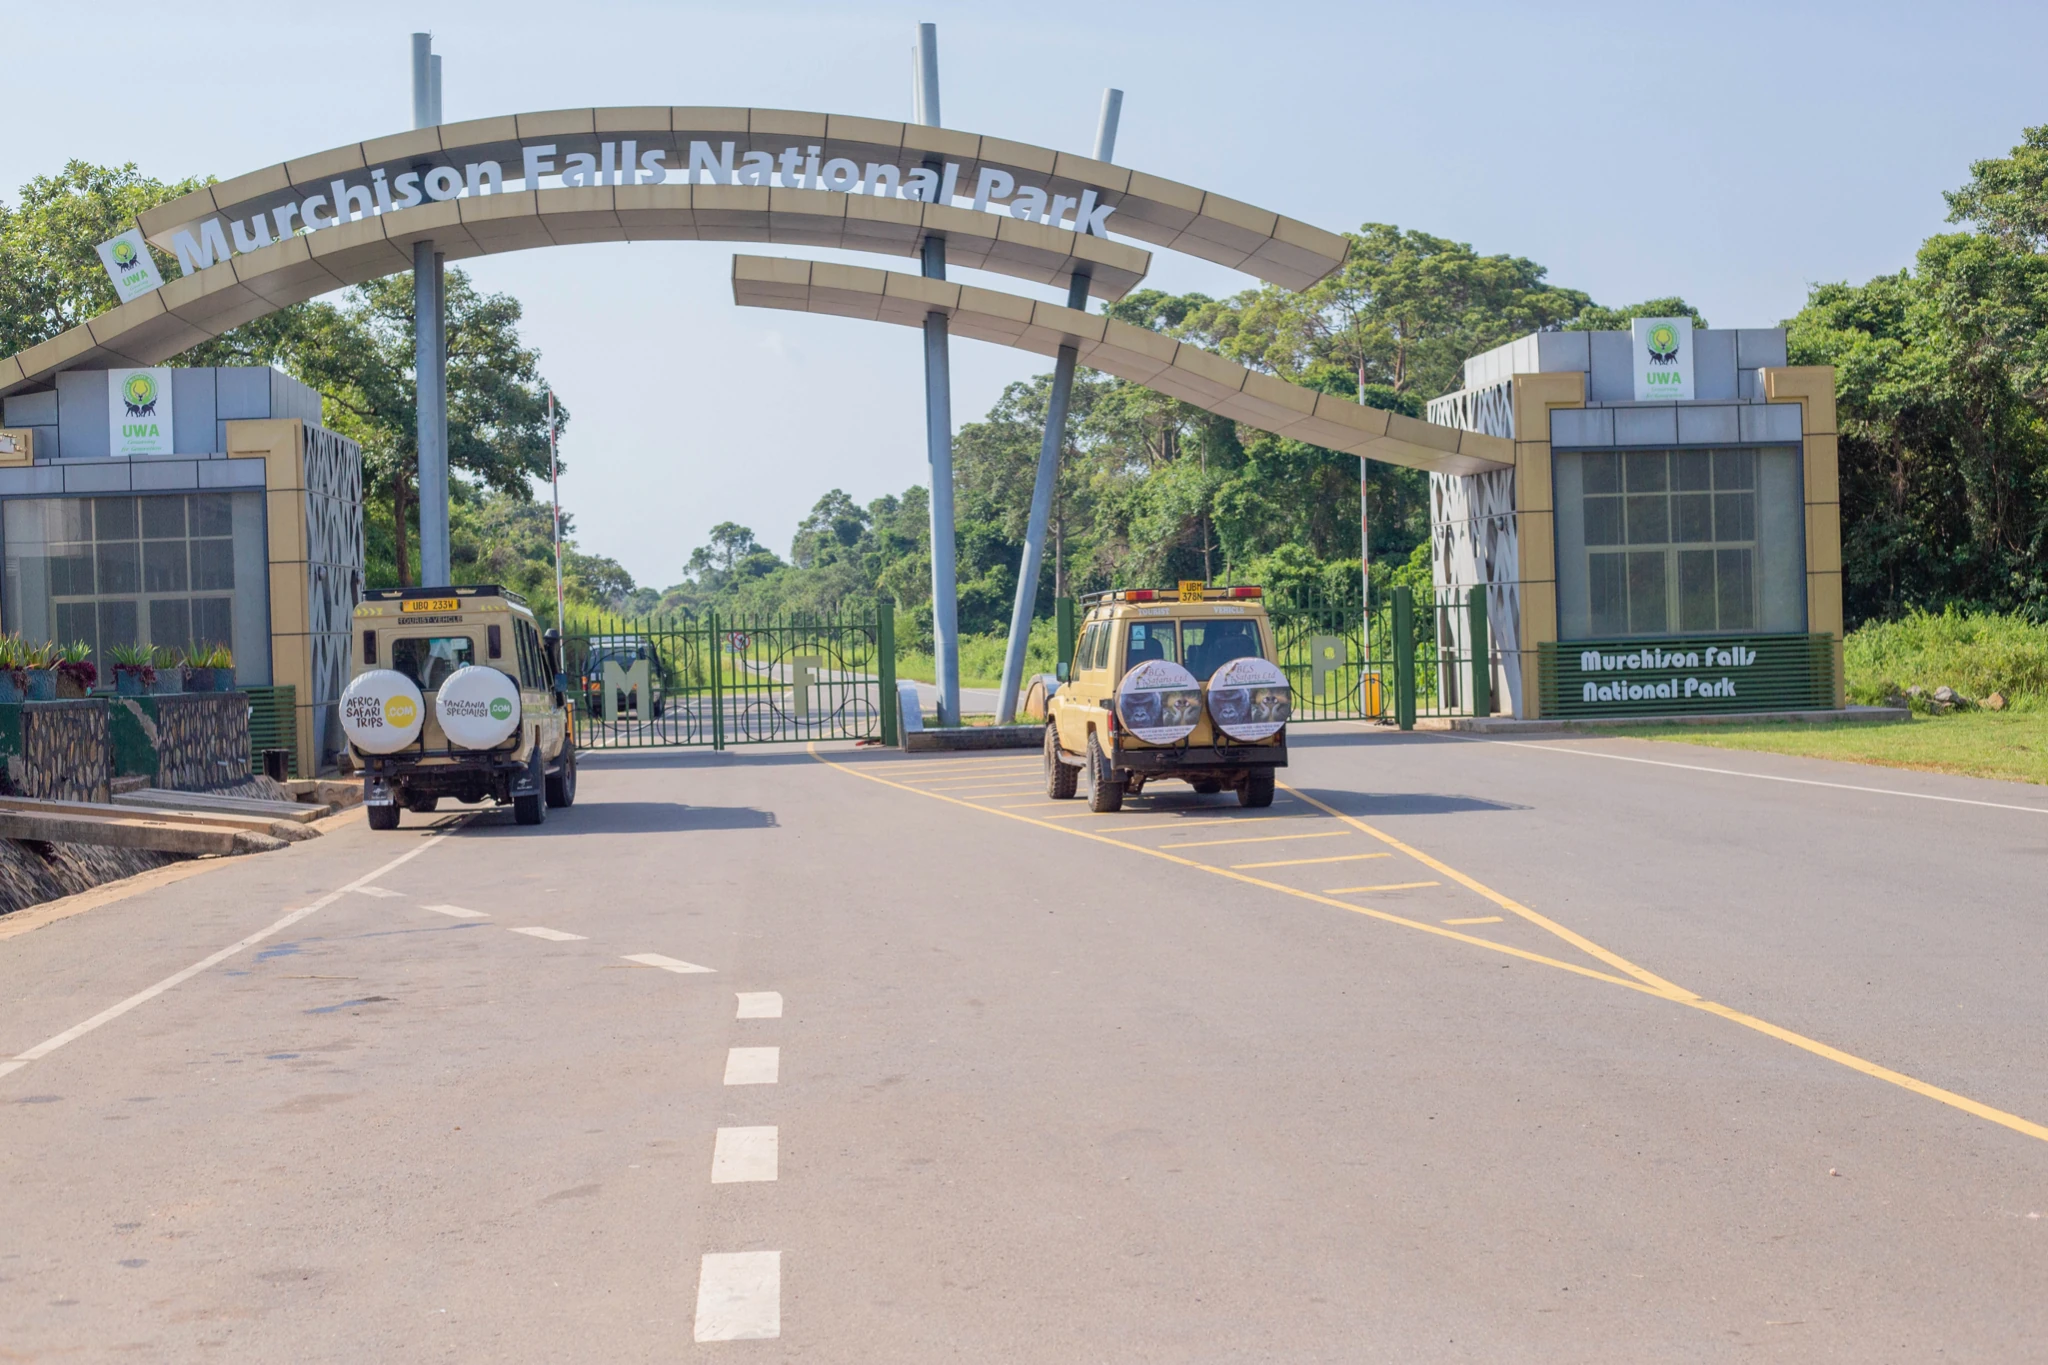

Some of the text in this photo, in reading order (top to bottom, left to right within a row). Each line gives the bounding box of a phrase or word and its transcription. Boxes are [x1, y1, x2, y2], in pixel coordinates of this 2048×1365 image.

[171, 140, 1117, 276] Murchison Falls National Park
[122, 269, 149, 287] UWA
[1646, 372, 1682, 385] UWA
[122, 424, 160, 438] UWA
[1186, 582, 1202, 592] UBM
[1182, 592, 1203, 601] 378N
[413, 600, 454, 611] UBQ 233W
[1138, 606, 1245, 616] TOURIST VEHICLE
[1581, 646, 1757, 672] Murchison Falls
[1311, 635, 1346, 696] P
[603, 655, 822, 721] M F
[1583, 677, 1737, 702] National Park
[346, 697, 380, 707] AFRICA
[443, 699, 486, 709] TANZANIA
[491, 702, 511, 713] .COM
[346, 707, 381, 718] SAFARI
[387, 706, 414, 717] .COM
[446, 707, 489, 718] SPECIALIST
[356, 717, 383, 728] TRIPS
